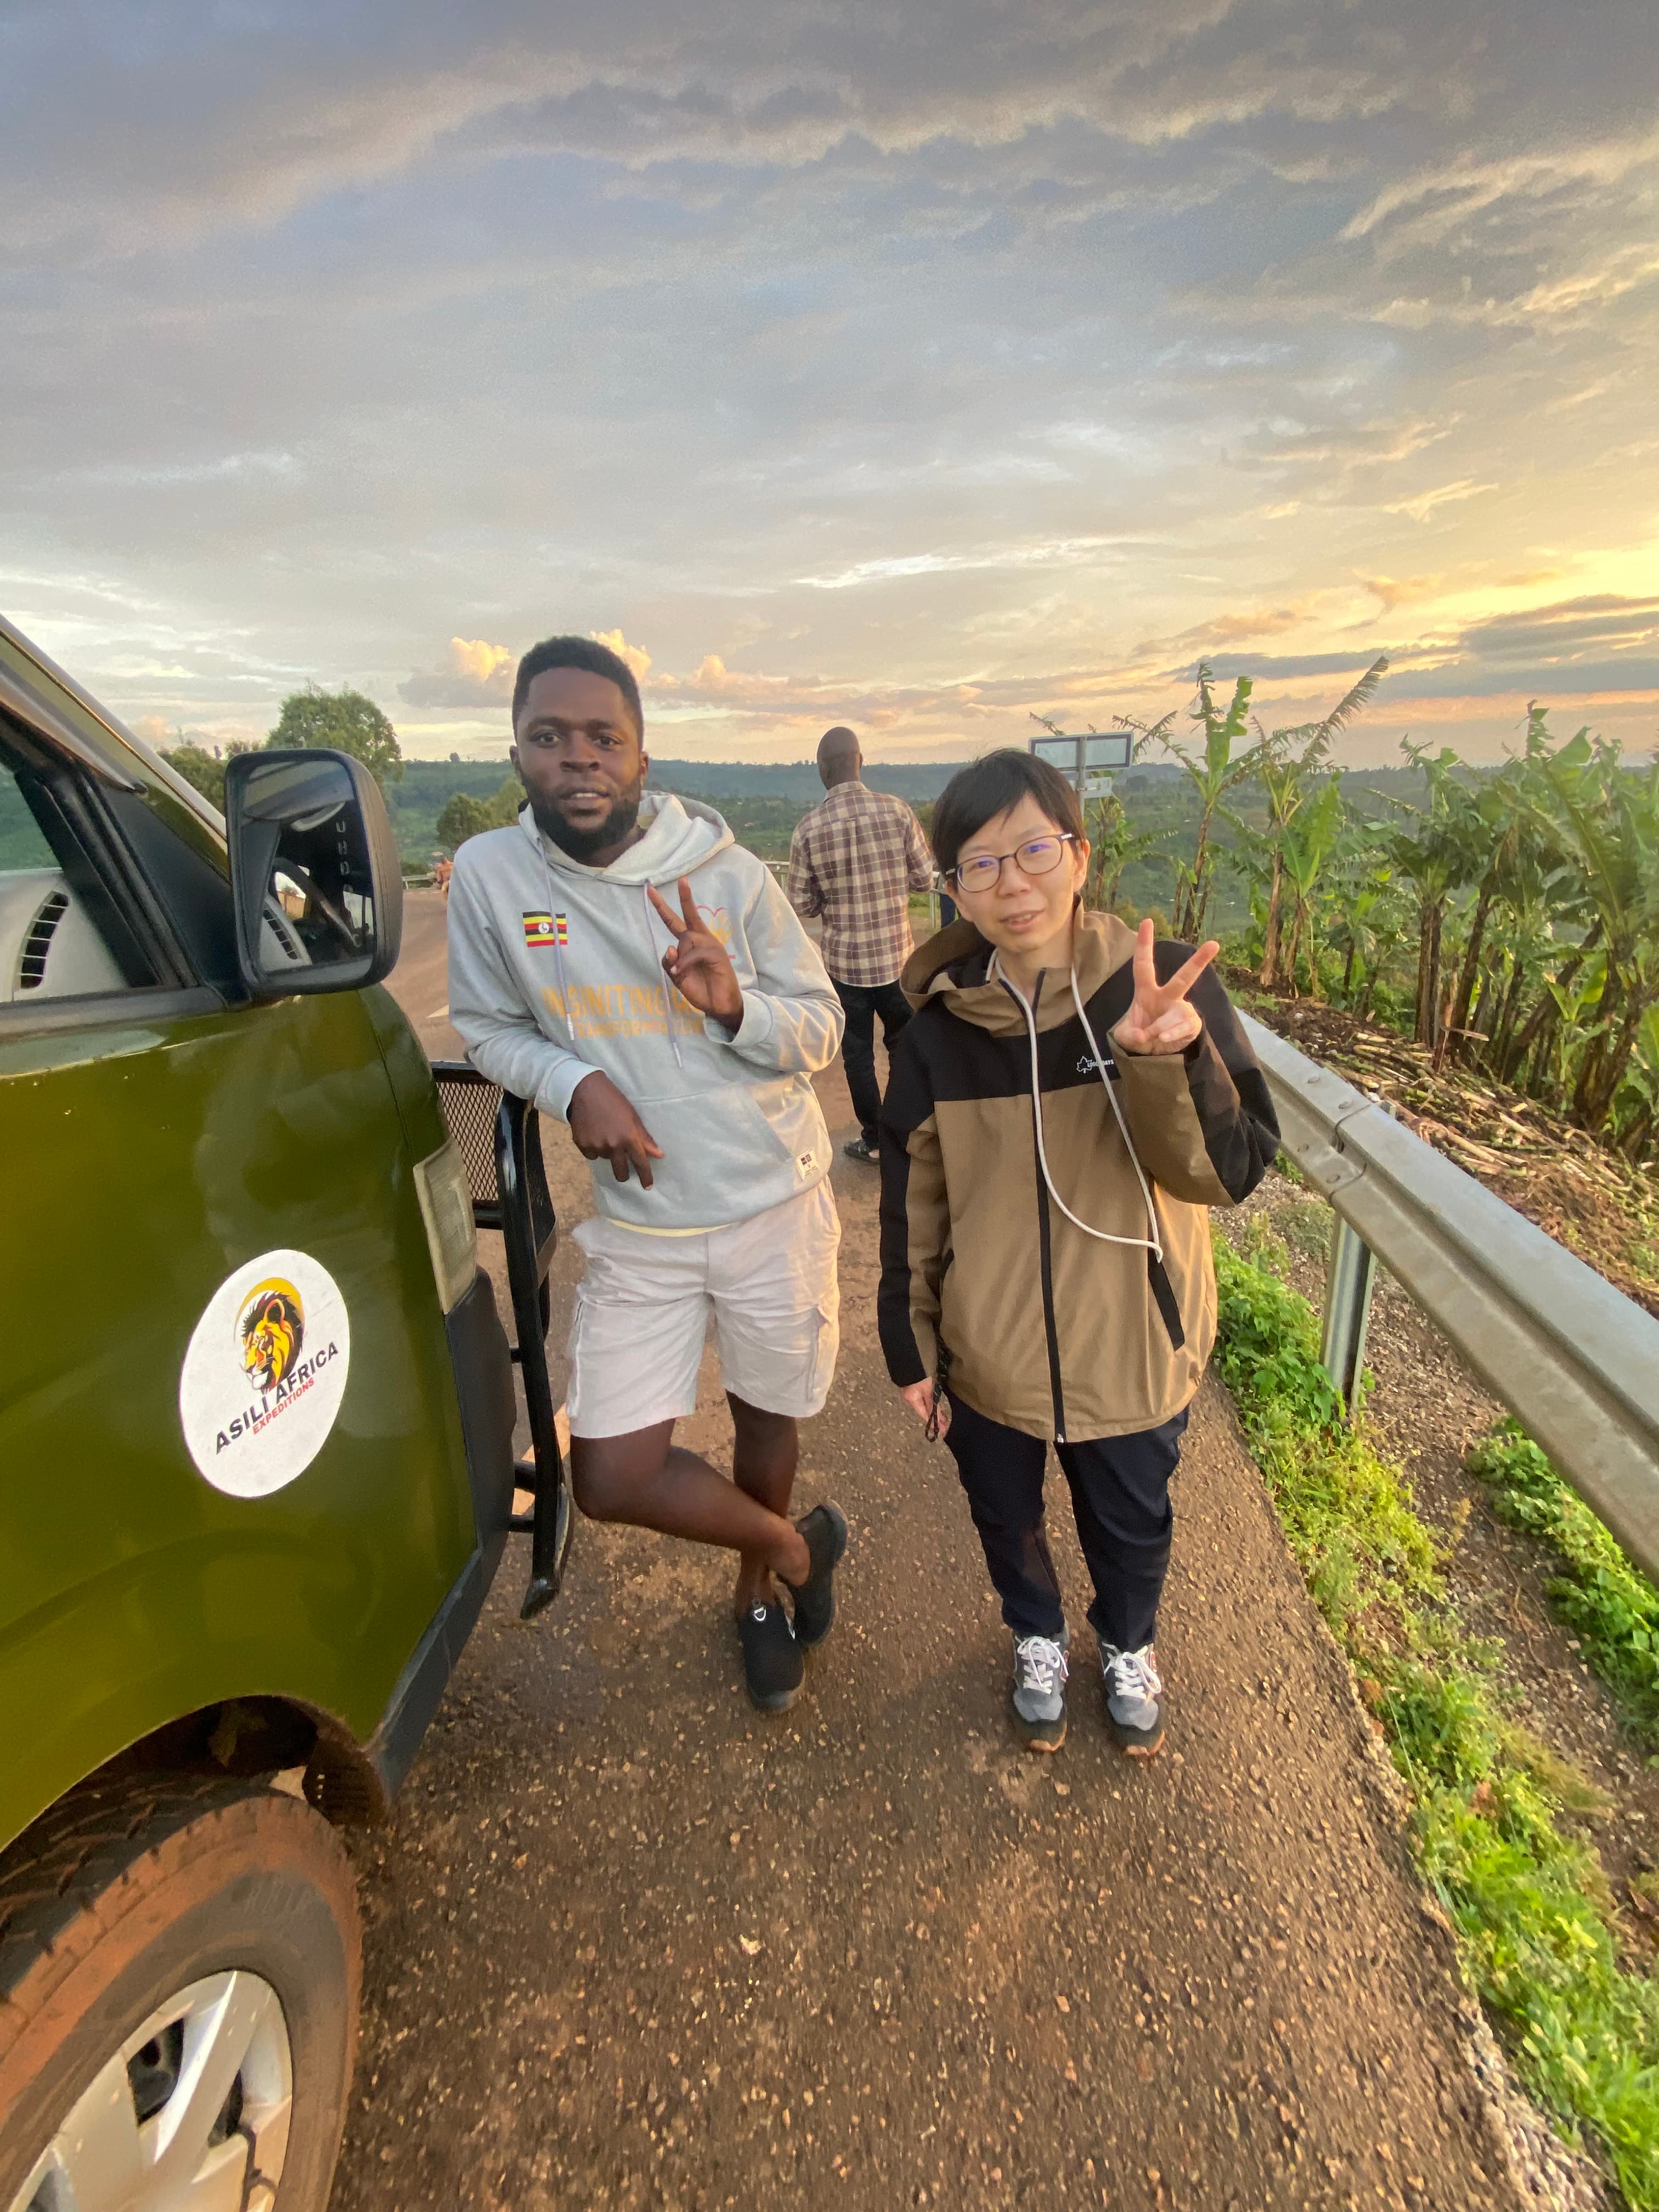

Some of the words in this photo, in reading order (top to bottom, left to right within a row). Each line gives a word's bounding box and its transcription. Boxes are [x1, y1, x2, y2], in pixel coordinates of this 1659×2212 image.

[216, 1396, 269, 1455] ASILI
[276, 1341, 339, 1404] AFRICA
[252, 1377, 315, 1435] EXPEDITIONS
